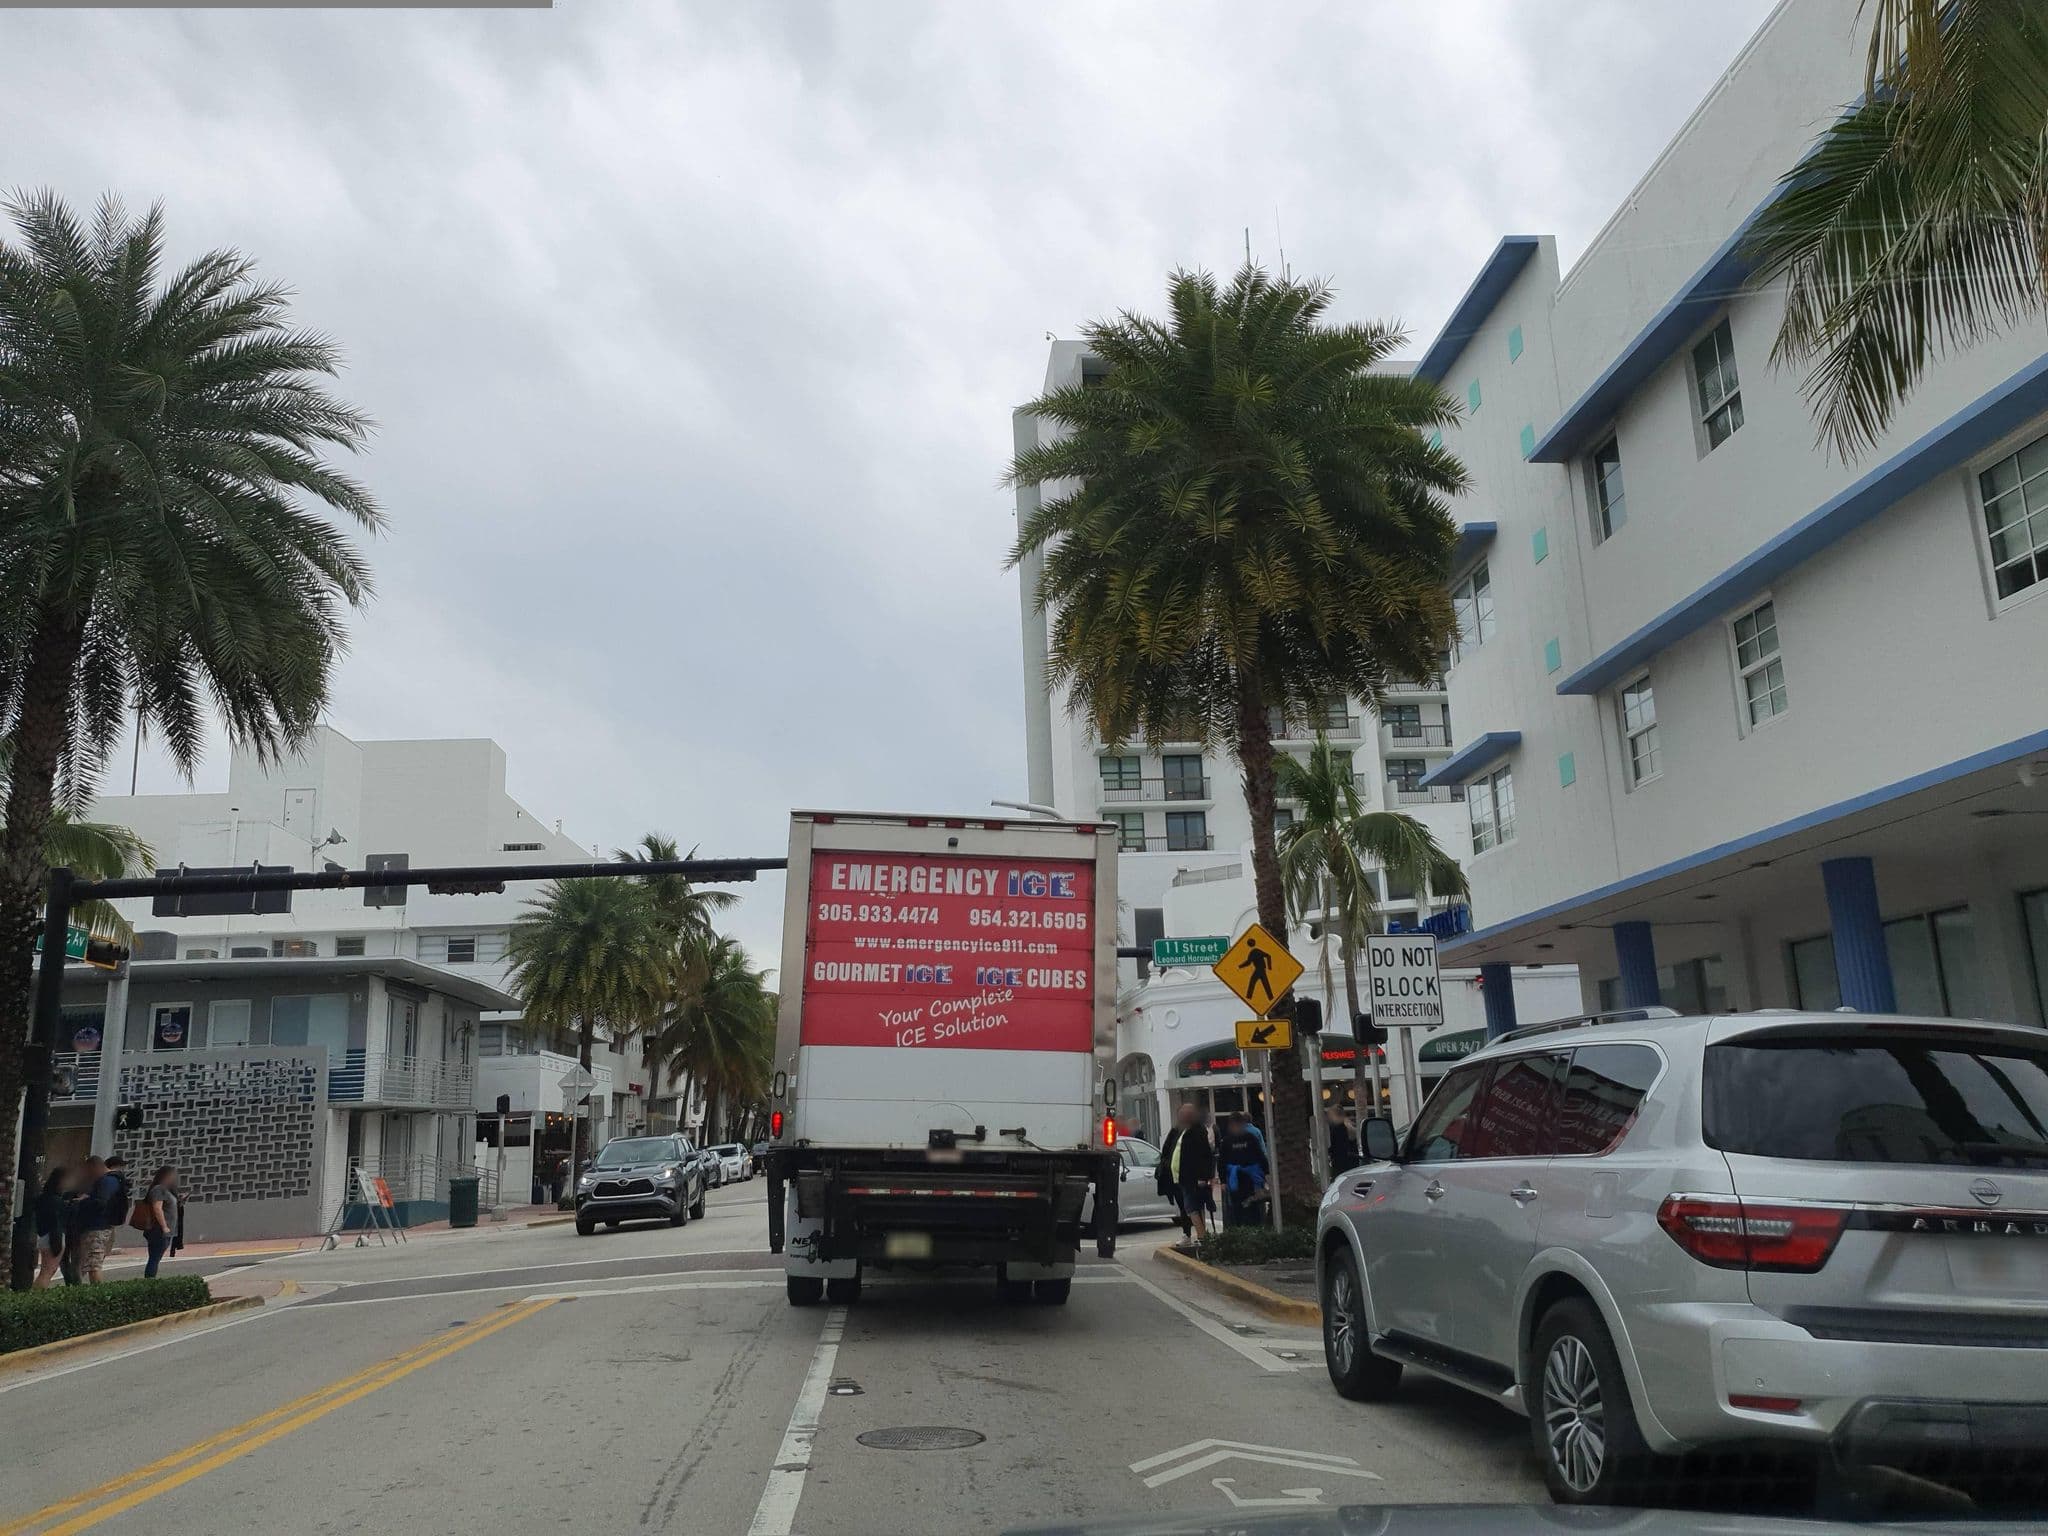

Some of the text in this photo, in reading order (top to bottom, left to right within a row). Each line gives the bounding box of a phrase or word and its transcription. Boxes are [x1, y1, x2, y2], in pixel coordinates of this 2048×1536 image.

[831, 863, 1075, 898] EMERGENCY ICE
[818, 903, 1087, 930] 305.933.4474 954.321.6505
[854, 936, 1058, 955] www.emergencyice911.com
[1165, 941, 1218, 953] 11 Street
[1372, 947, 1434, 967] DO NOT
[813, 961, 953, 985] GOURMET ICE
[976, 966, 1087, 990] ICE CUBES
[1374, 976, 1438, 997] BLOCK
[878, 988, 1015, 1027] Your Complete
[1375, 1002, 1441, 1018] INTERSECTION
[896, 1012, 1009, 1048] ICE Solution
[1435, 1041, 1458, 1054] OPEN
